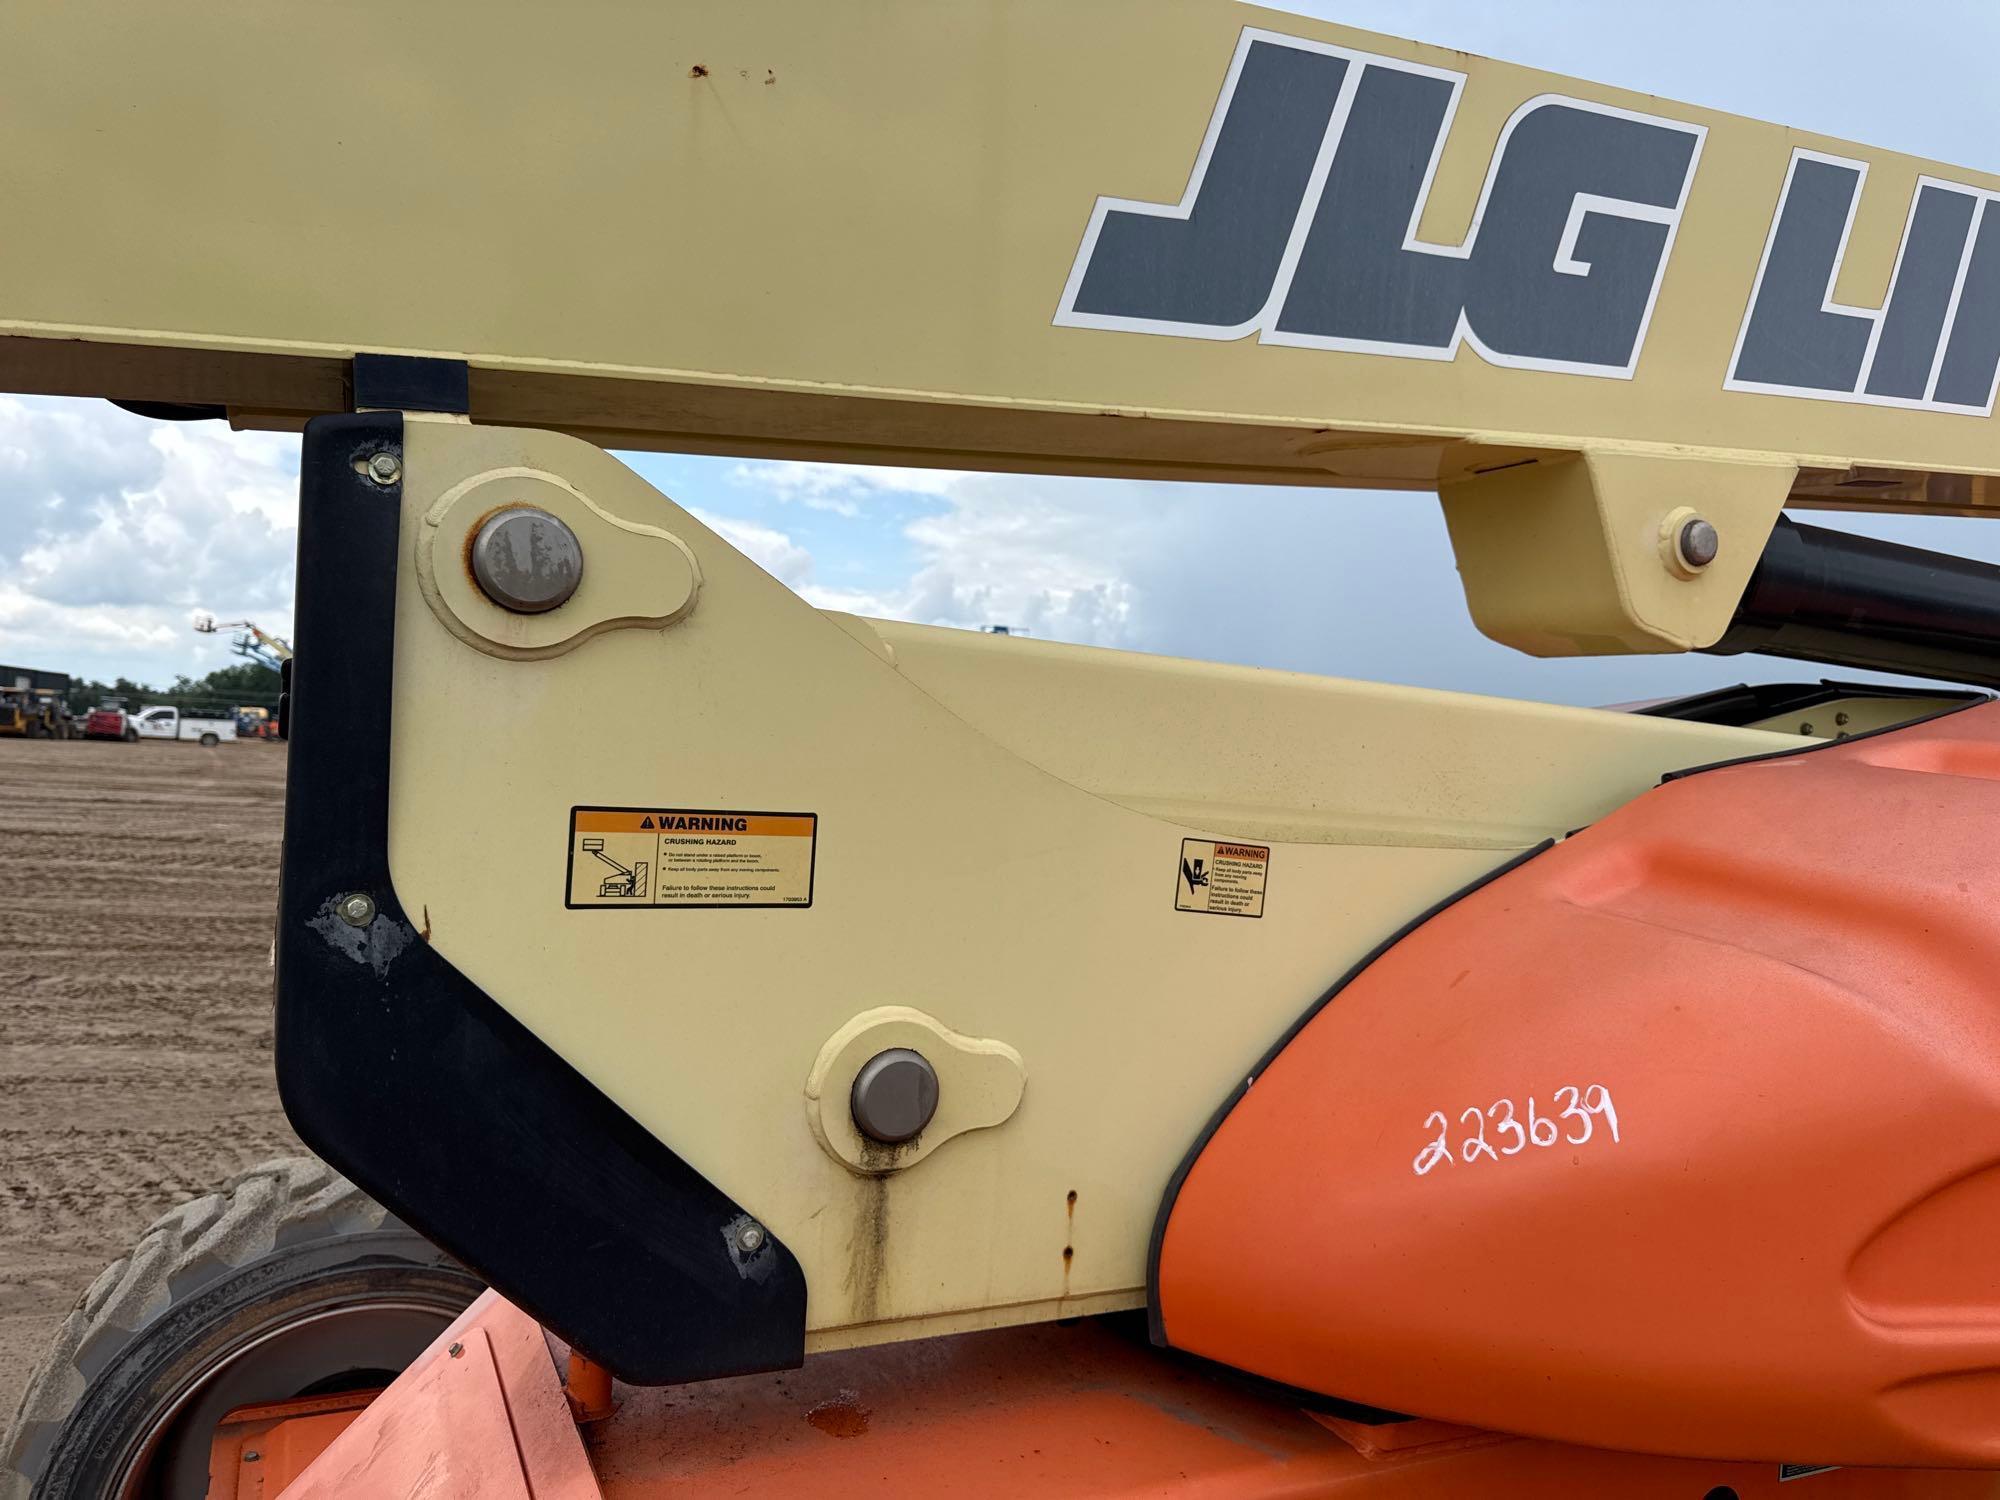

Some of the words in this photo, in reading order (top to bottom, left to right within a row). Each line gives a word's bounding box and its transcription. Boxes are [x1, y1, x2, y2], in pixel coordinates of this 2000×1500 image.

[1052, 26, 1708, 381] JLG
[658, 816, 748, 832] WARNING
[1226, 846, 1265, 859] WARNING
[1412, 1083, 1620, 1176] 223639
